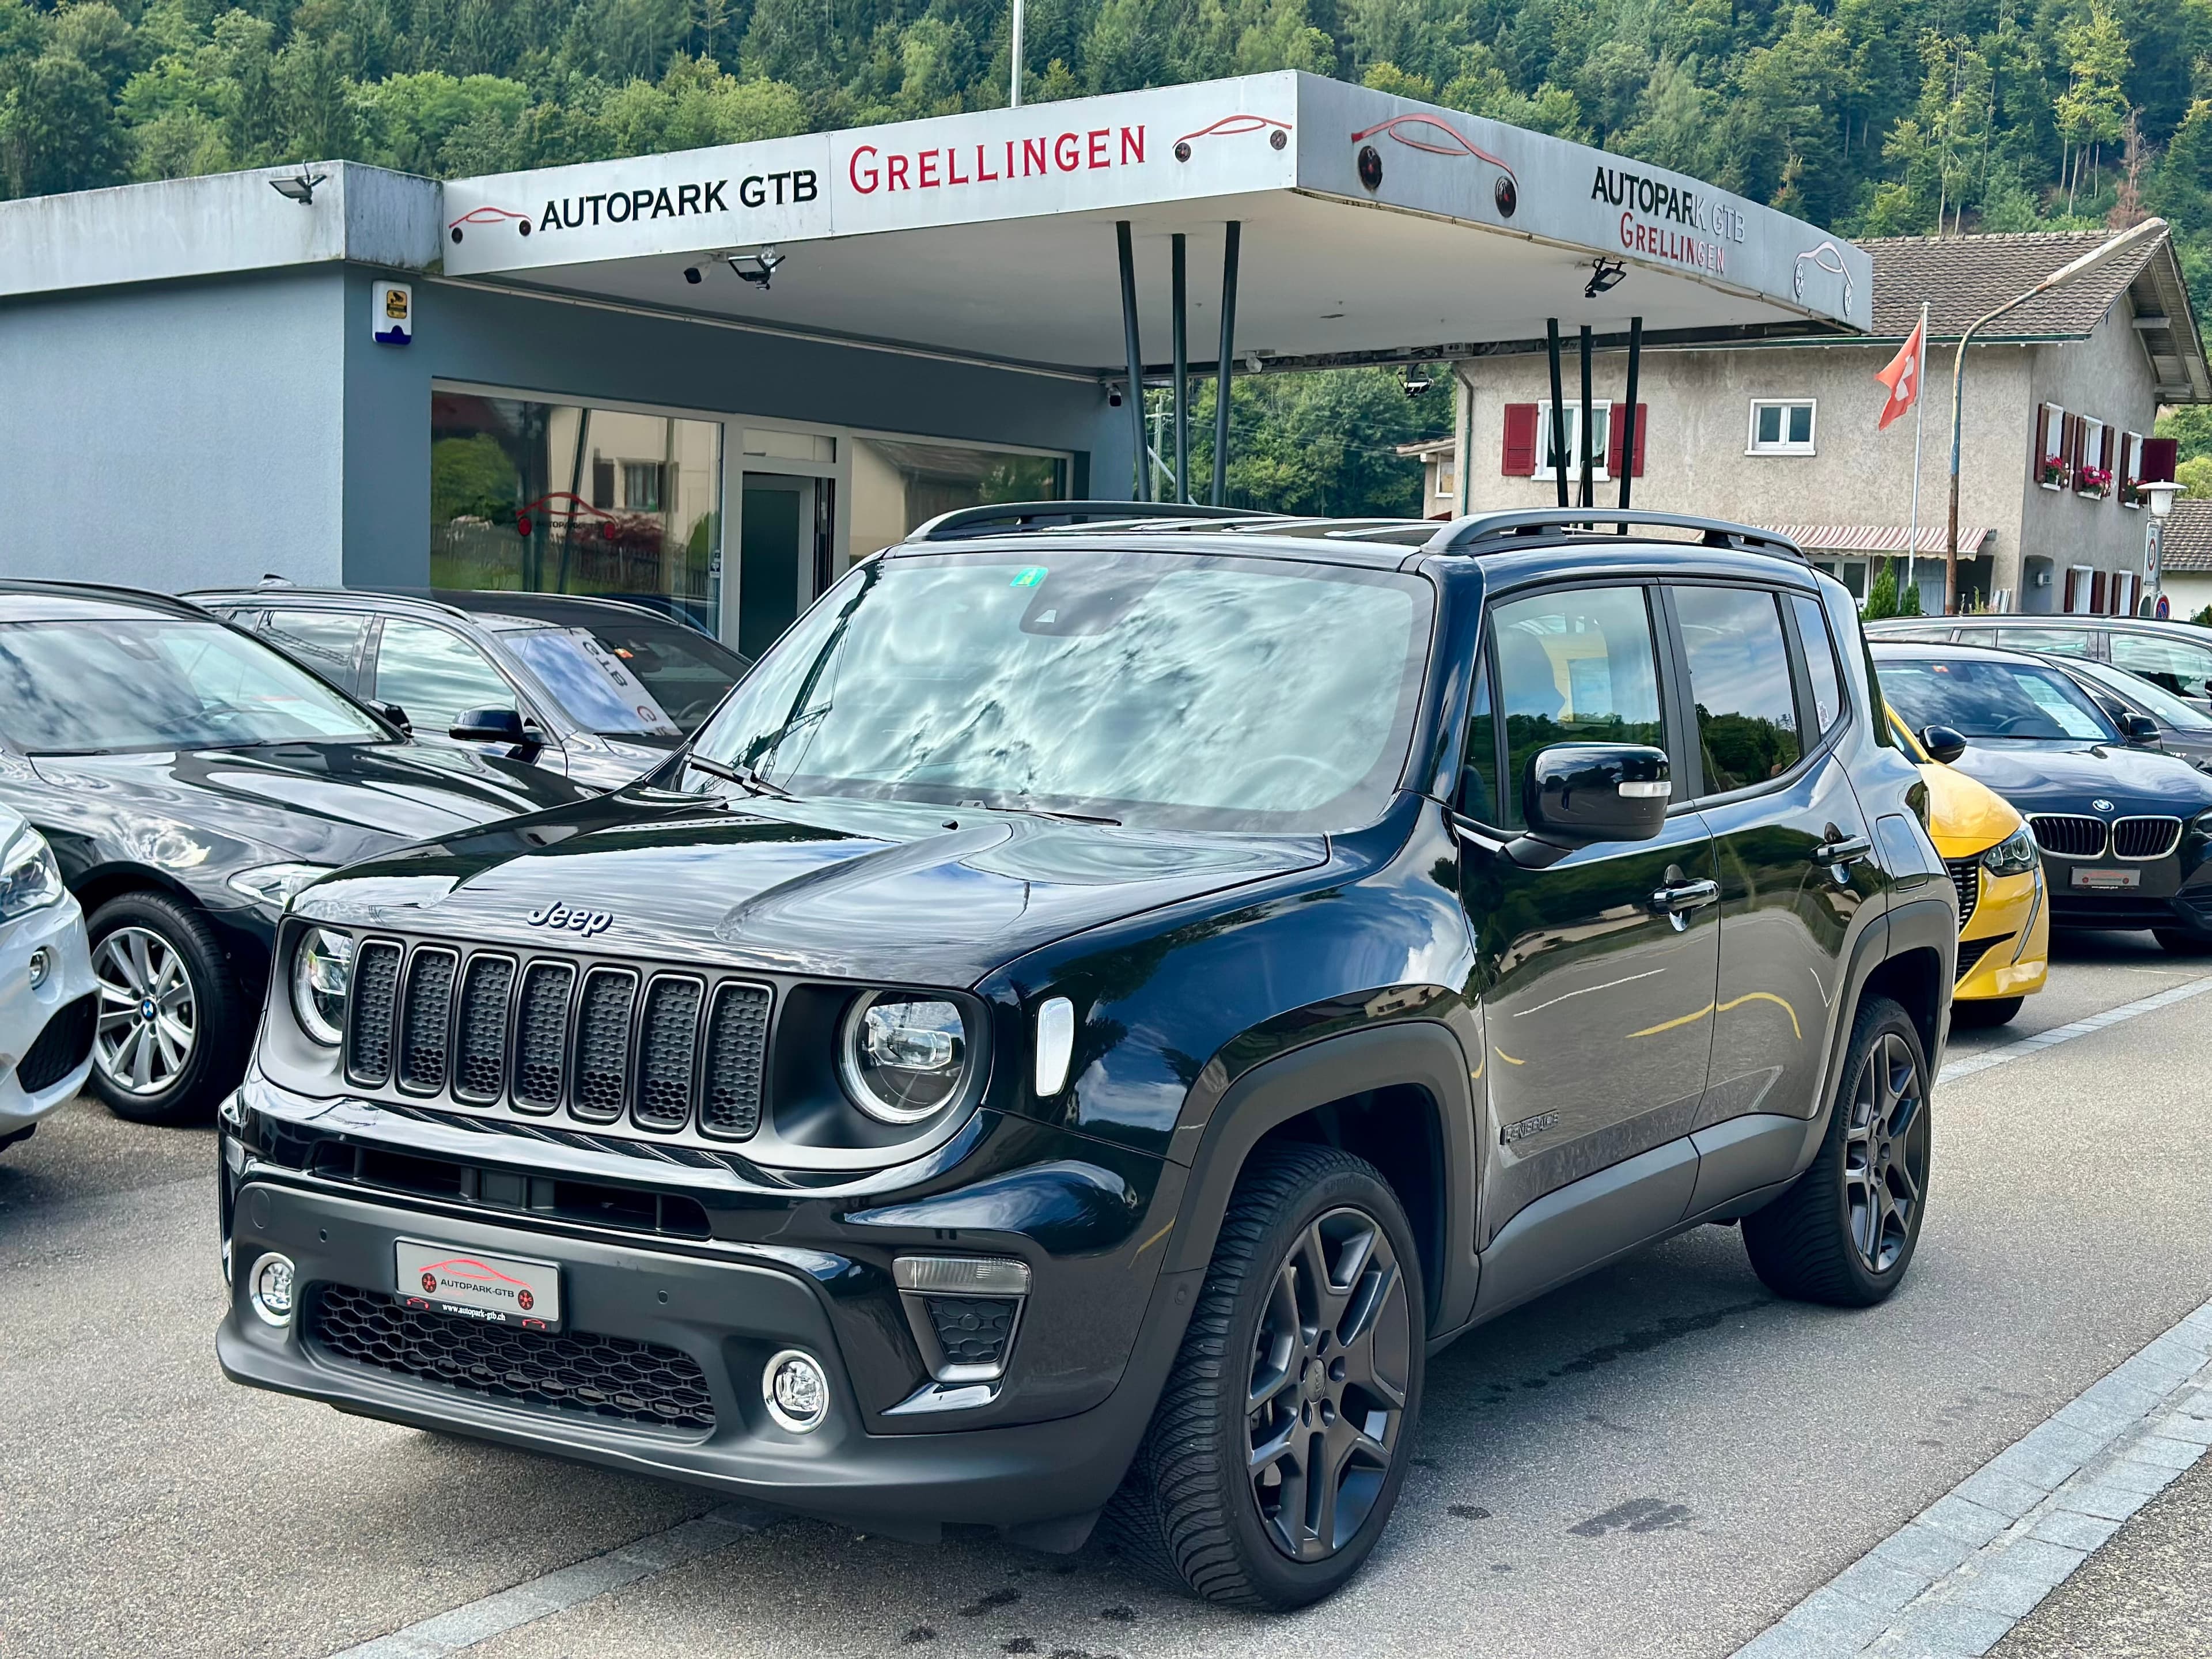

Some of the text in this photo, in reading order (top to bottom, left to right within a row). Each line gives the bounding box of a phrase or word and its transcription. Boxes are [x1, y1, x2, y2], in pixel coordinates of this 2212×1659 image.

[539, 125, 1145, 232] AUTOPARK GTB GRELLINGEN
[1590, 165, 1745, 244] AUTOPARK GTB
[527, 900, 613, 938] Jeep
[440, 1278, 515, 1298] AUTOPARK-GTB
[442, 1303, 506, 1321] www.autopark-gtb.ch
